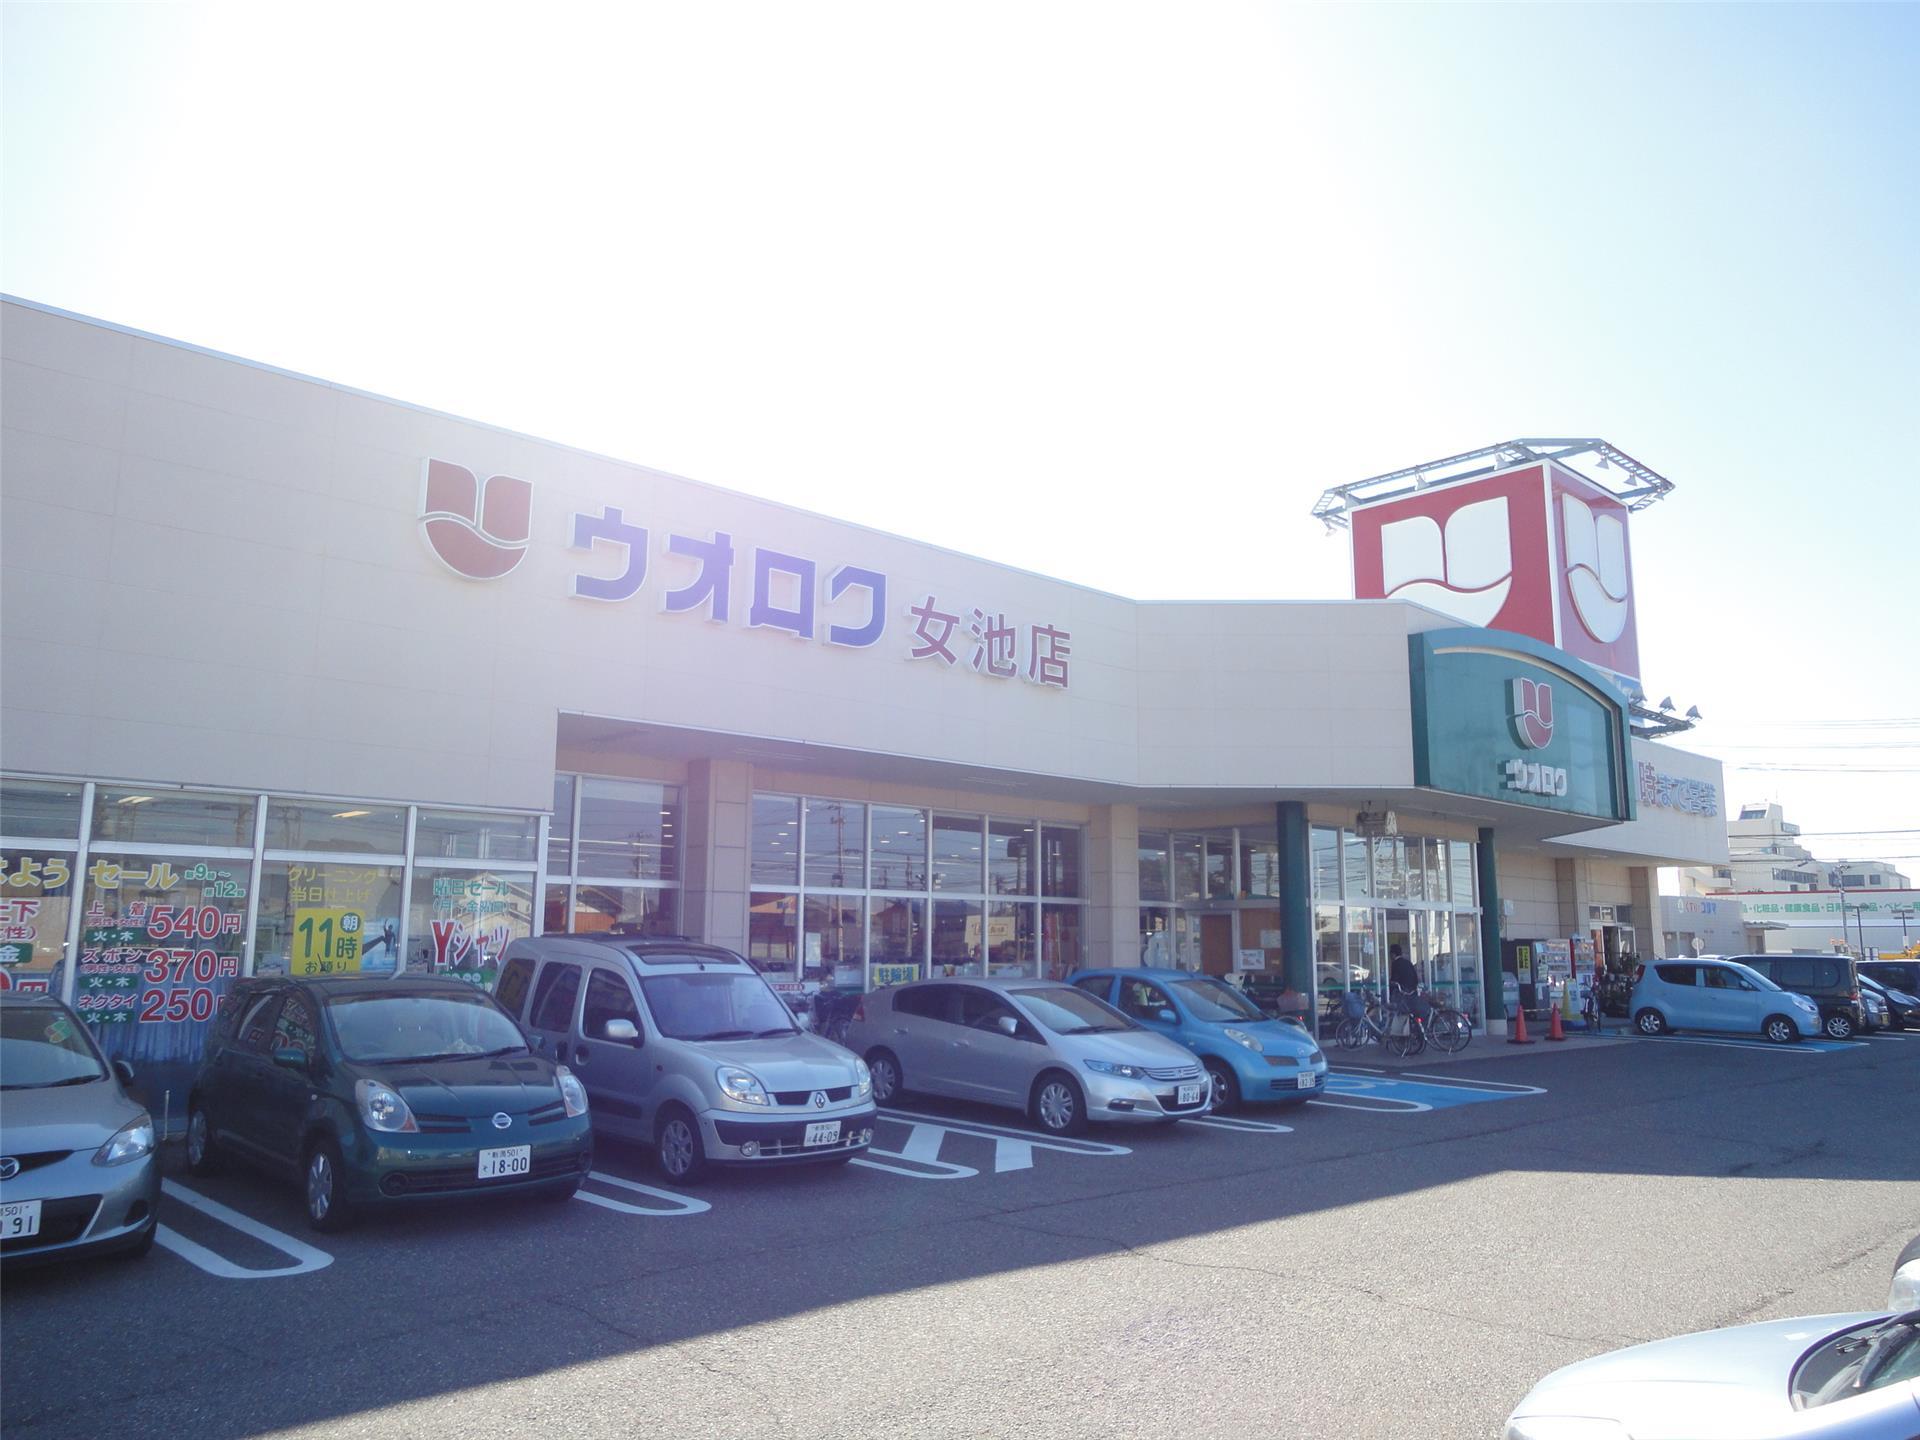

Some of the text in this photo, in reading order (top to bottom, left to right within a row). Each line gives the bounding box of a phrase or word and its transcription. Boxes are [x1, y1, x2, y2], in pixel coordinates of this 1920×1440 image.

[567, 504, 1073, 690] ウオロク 女池店
[1505, 759, 1567, 796] ウオロク
[1638, 761, 1717, 816] 時まで営業
[90, 860, 178, 888] セール
[288, 866, 378, 884] クリーニング
[78, 993, 137, 1010] ネクタイ
[139, 987, 225, 1023] 250
[492, 1157, 527, 1175] 18-00
